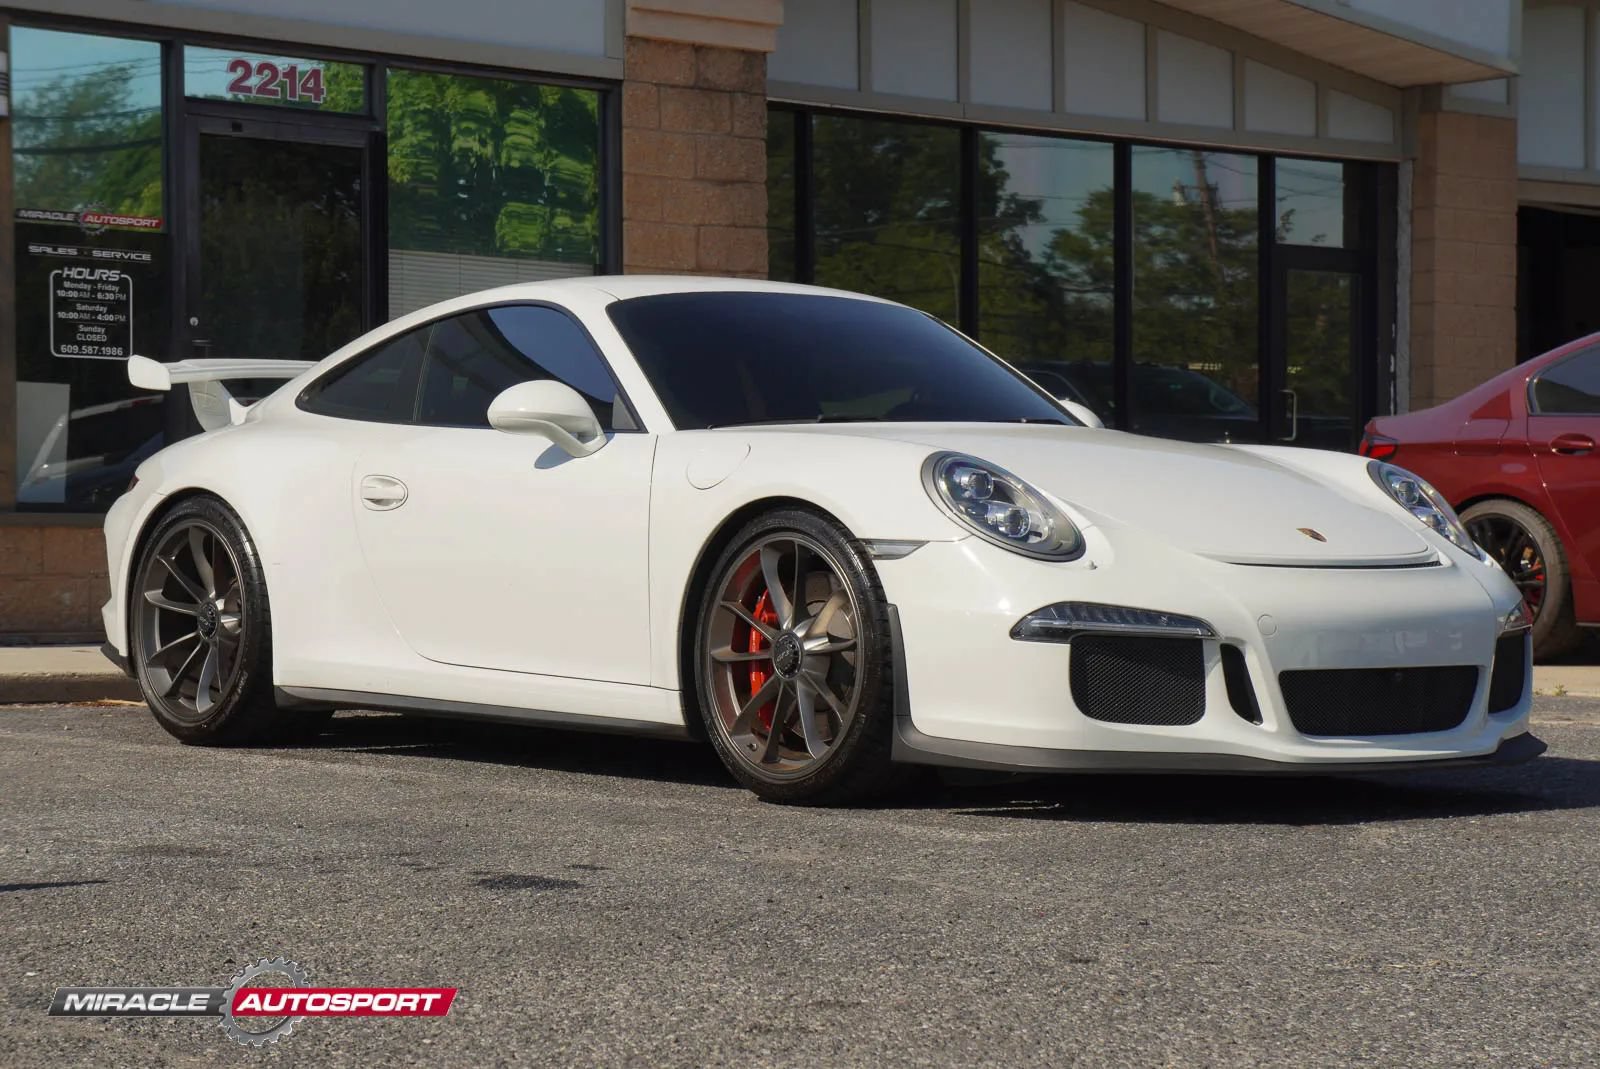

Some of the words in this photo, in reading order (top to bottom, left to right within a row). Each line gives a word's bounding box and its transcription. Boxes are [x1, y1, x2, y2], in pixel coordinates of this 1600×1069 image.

[227, 58, 326, 103] 2214
[18, 210, 76, 221] MIRACLE
[85, 214, 159, 227] AUTOSPORT
[28, 245, 78, 255] SALES
[92, 250, 152, 261] SERVICE
[63, 267, 120, 281] HOURS
[63, 281, 91, 290] Monday
[97, 284, 120, 292] Friday
[76, 303, 108, 313] Saturday
[79, 324, 106, 334] Sunday
[76, 333, 108, 341] CLOSED
[60, 344, 124, 356] 609.587.1986
